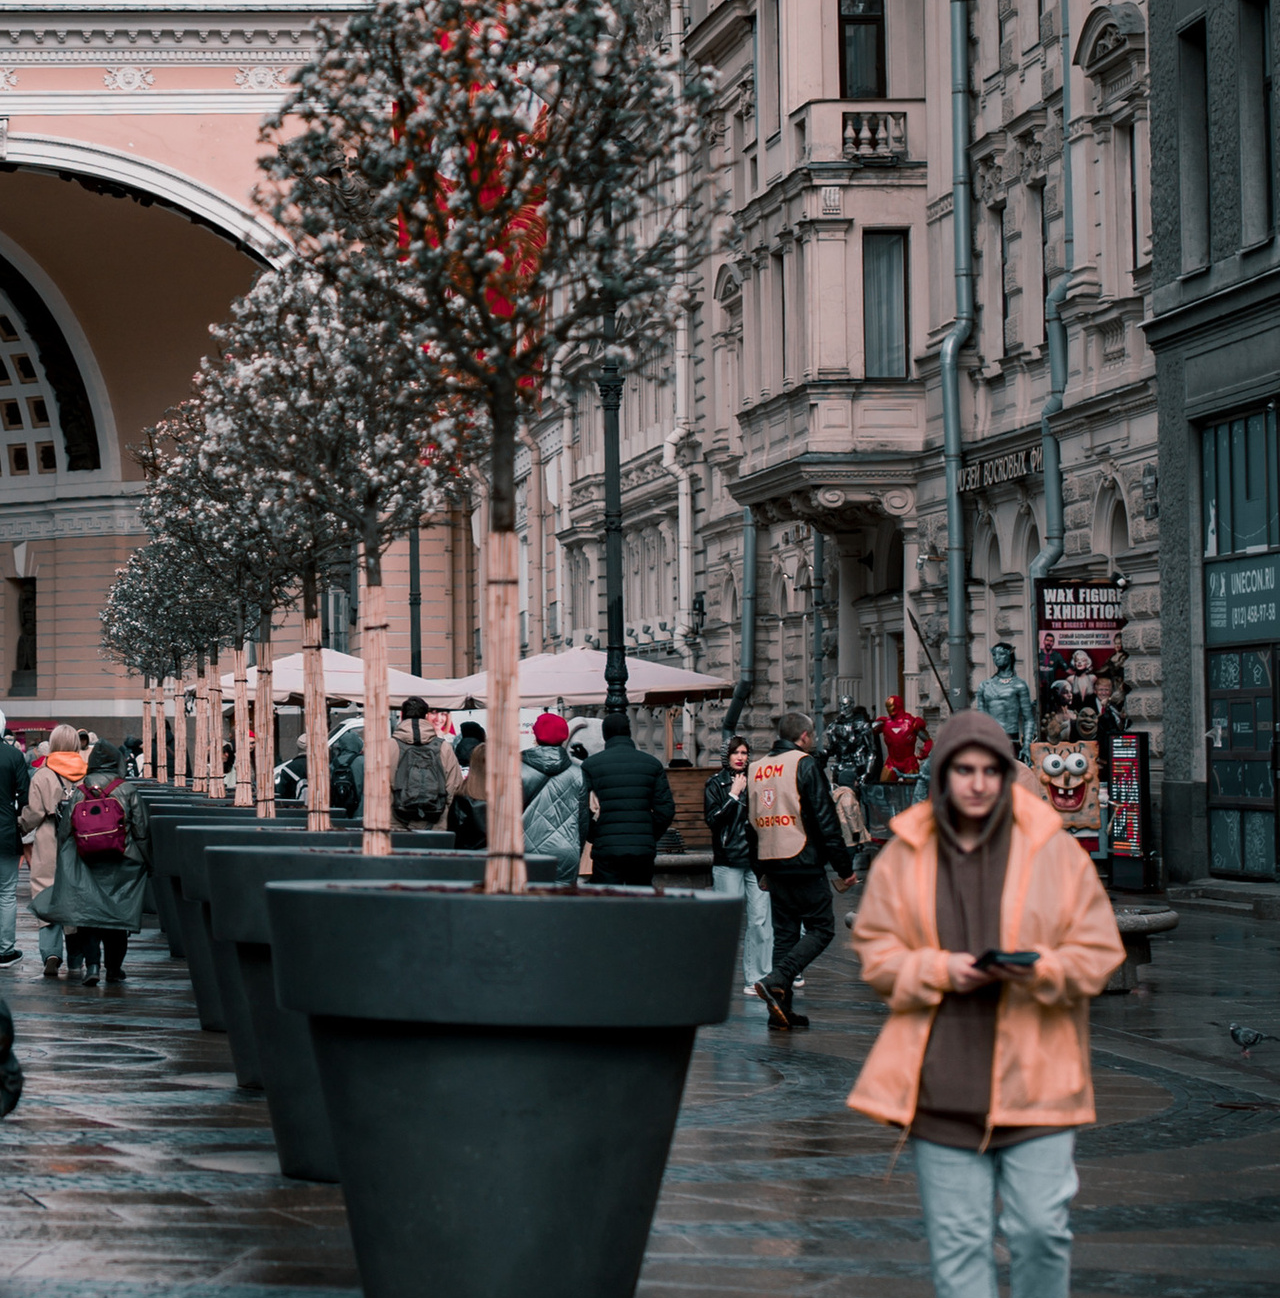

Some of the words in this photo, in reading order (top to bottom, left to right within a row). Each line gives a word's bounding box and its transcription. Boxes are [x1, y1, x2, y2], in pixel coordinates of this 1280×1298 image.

[983, 450, 1027, 486] ВОСКОВЫХ
[1231, 567, 1275, 595] UNECON.RU
[1043, 588, 1075, 603] WAX
[1045, 604, 1124, 620] EXHIBITION
[754, 764, 784, 782] ДОМ
